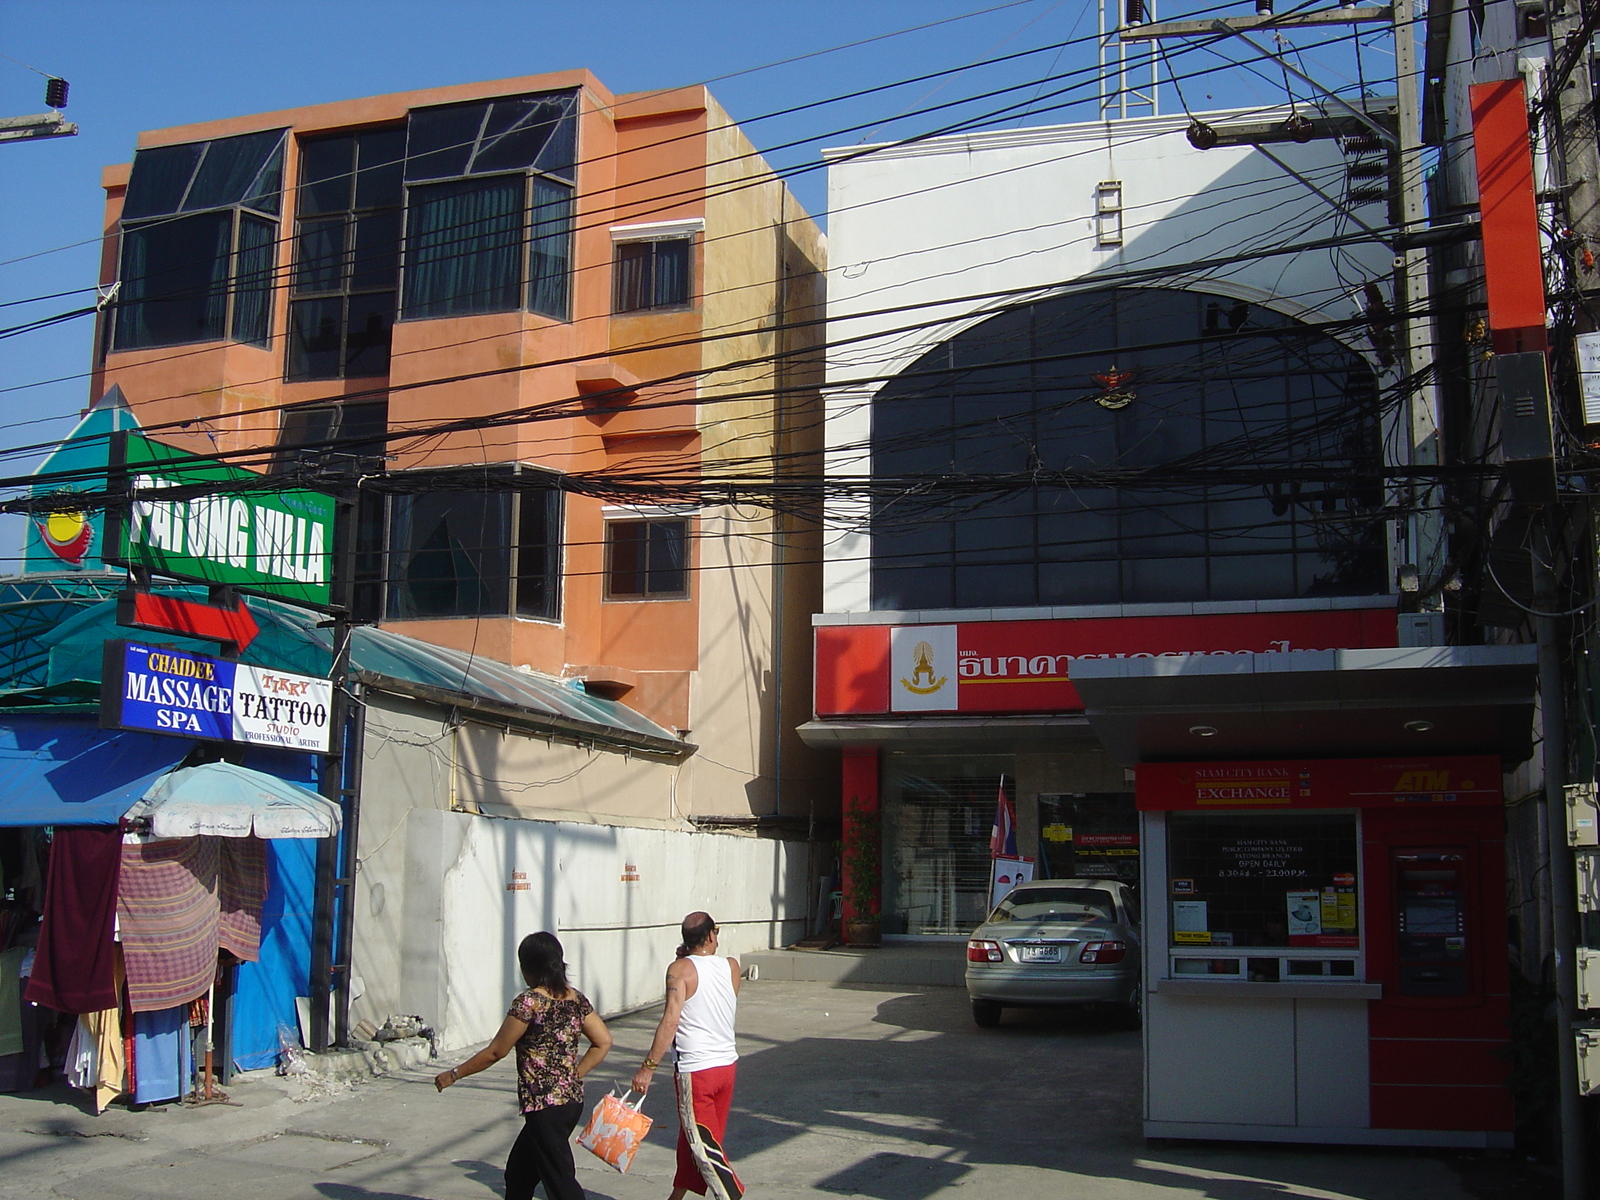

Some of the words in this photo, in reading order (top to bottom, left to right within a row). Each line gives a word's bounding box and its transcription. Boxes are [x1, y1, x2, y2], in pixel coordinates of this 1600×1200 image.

[255, 505, 325, 587] VILLA
[148, 652, 216, 682] CHAIDEE
[126, 671, 232, 715] MASSAGE
[156, 709, 203, 732] SPA
[239, 692, 328, 728] TATTOO
[245, 730, 293, 745] PROFESSIONAL
[298, 737, 321, 748] ARTIST
[266, 722, 301, 737] STUDIO
[1196, 769, 1224, 778] SIAM
[1227, 768, 1252, 778] CITY
[1257, 768, 1289, 777] BANK
[1394, 770, 1450, 792] ATM
[1197, 787, 1291, 799] EXCHANGE
[1238, 860, 1260, 868] OPEN
[1263, 860, 1287, 868] DAILY
